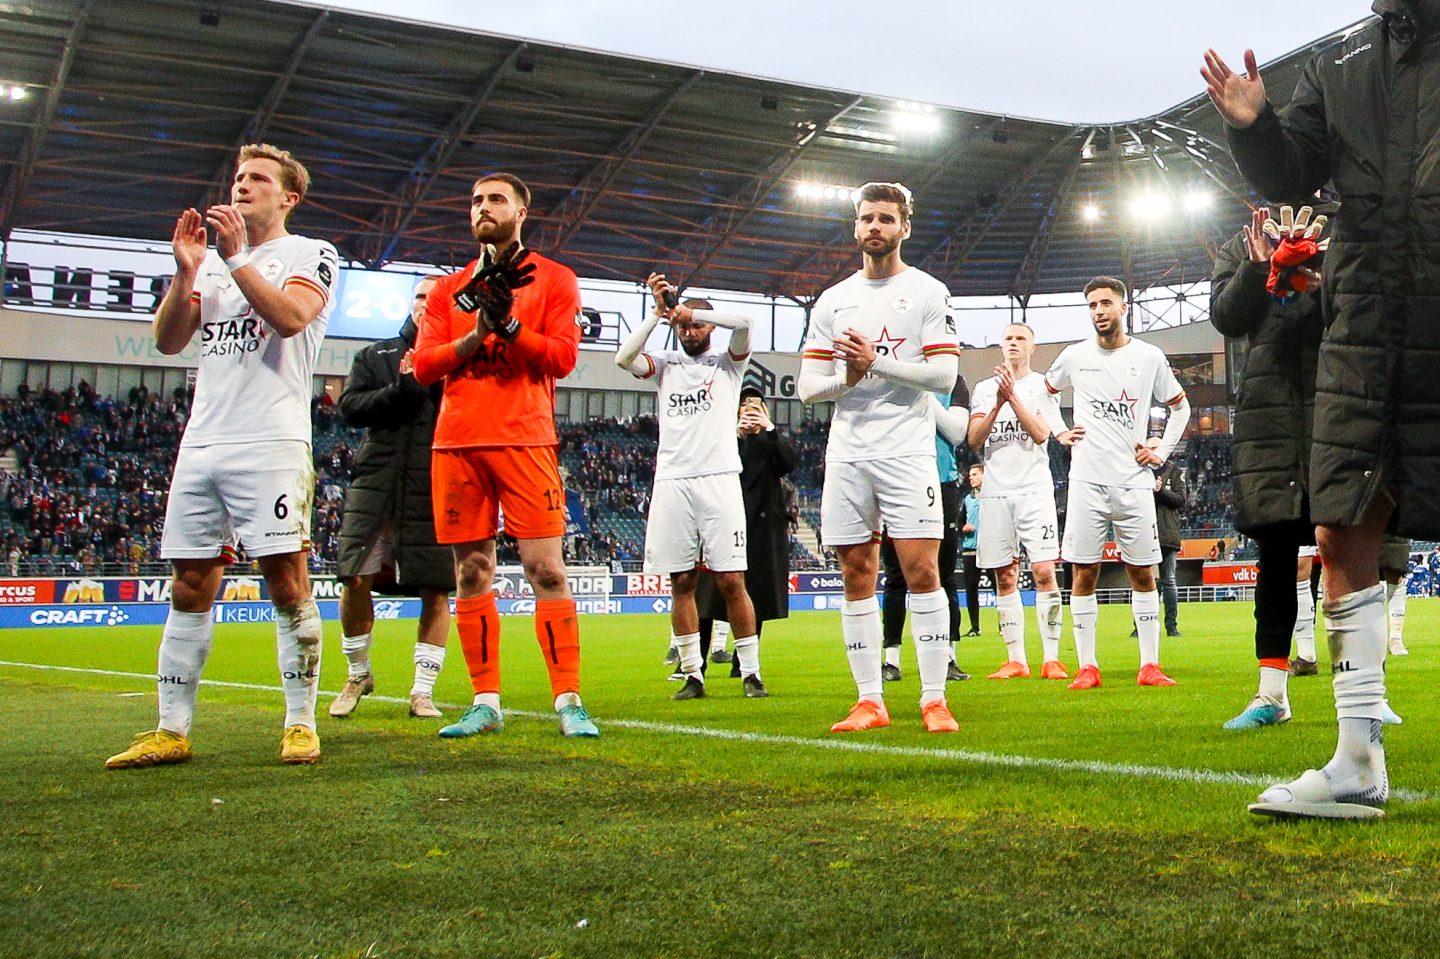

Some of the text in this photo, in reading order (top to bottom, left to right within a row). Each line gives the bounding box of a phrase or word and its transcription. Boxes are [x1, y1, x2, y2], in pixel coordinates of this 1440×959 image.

[202, 319, 258, 342] STAR
[668, 391, 708, 407] STAR
[926, 486, 935, 507] 9
[274, 493, 288, 520] 6
[1233, 568, 1250, 581] vdk
[30, 610, 110, 625] CRAFT
